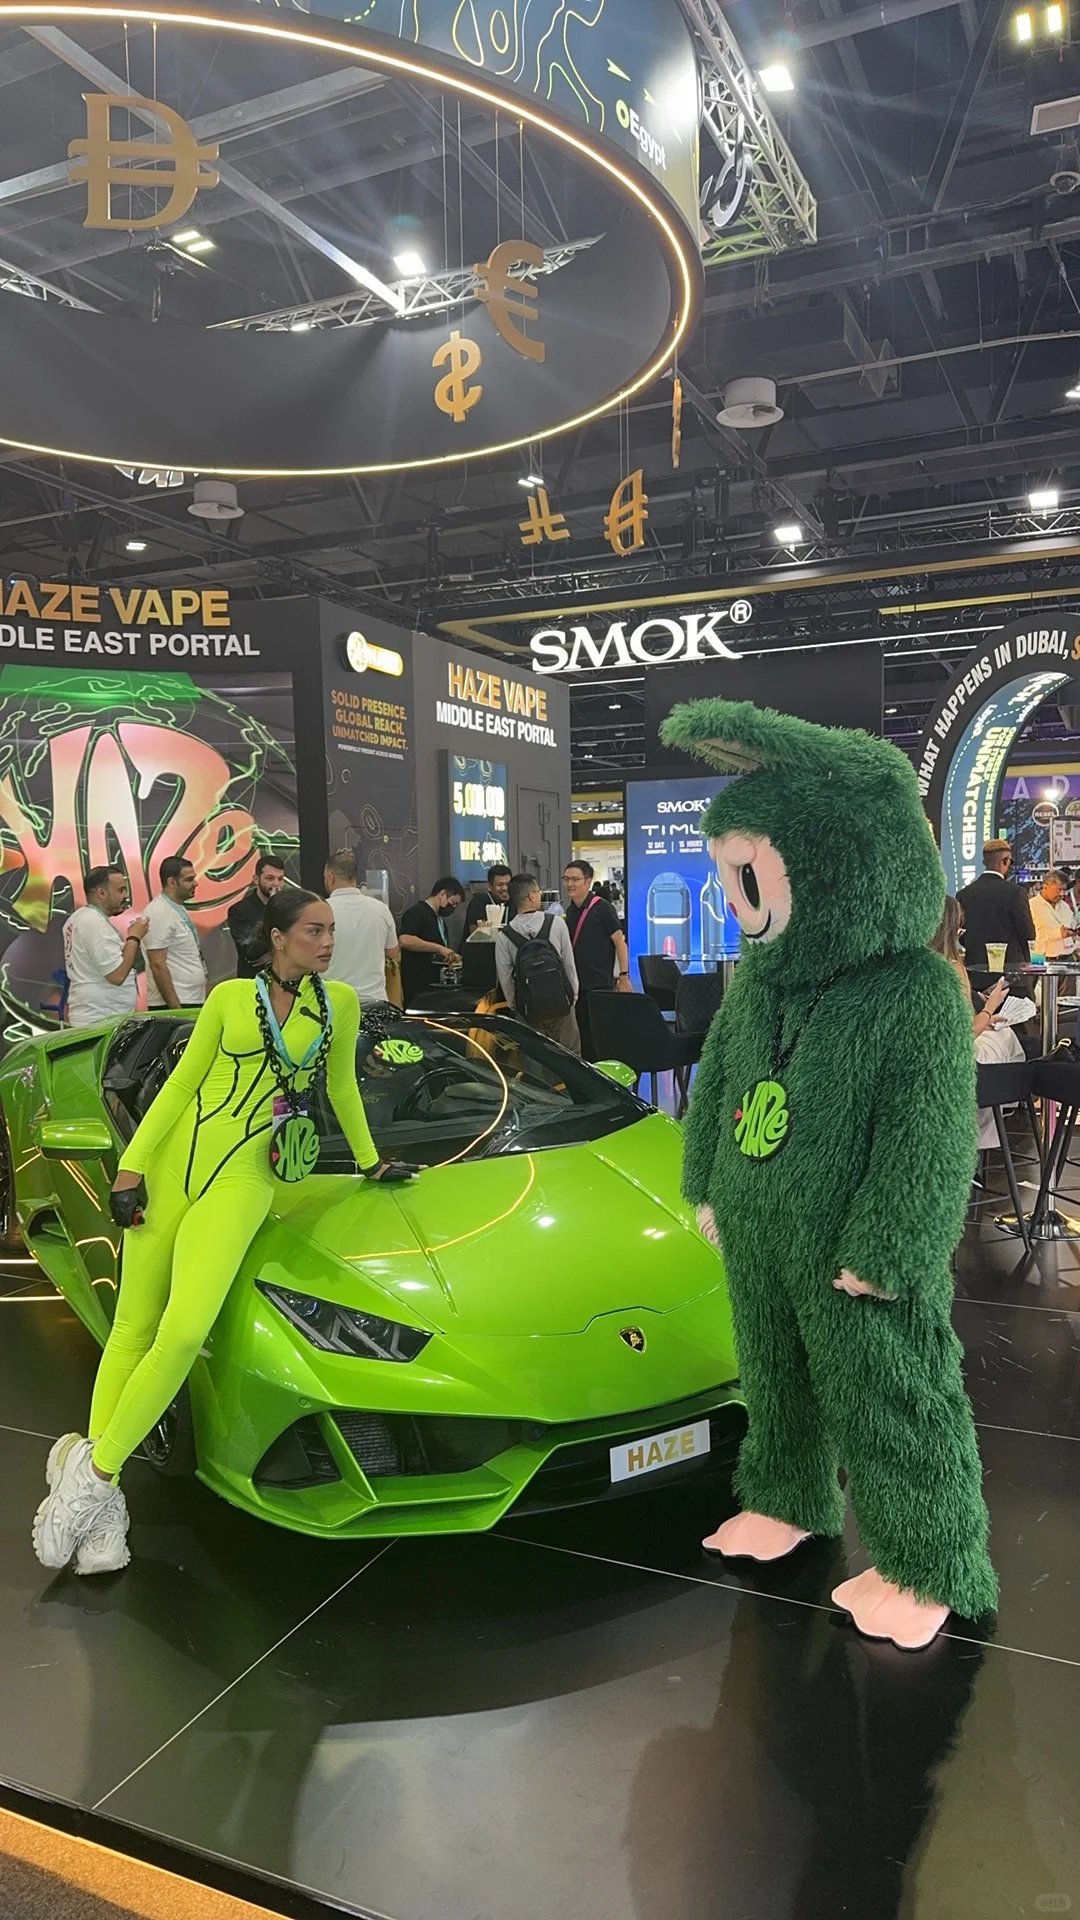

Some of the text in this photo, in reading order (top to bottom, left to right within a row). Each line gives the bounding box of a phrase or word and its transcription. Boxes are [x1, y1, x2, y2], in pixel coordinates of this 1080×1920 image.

[630, 108, 666, 171] Egypt
[108, 588, 230, 626] VAPE
[64, 629, 141, 654] EAST
[150, 633, 260, 656] PORTAL
[331, 689, 407, 720] SOLID PRESENCE.
[448, 662, 547, 721] HAZE VAPE
[335, 708, 405, 736] GLOBAL REACH.
[436, 700, 557, 747] MIDDLE EAST PORTAL
[917, 737, 940, 797] WHAT
[934, 656, 993, 739] HAPPENS
[994, 641, 1012, 669] IN
[1016, 630, 1069, 660] DUBAI,
[332, 725, 409, 750] UNMATCHED IMPACT.
[962, 726, 1002, 860] UNMATCHED
[459, 841, 502, 862] VAPE SOLD
[628, 1430, 695, 1473] HAZE
